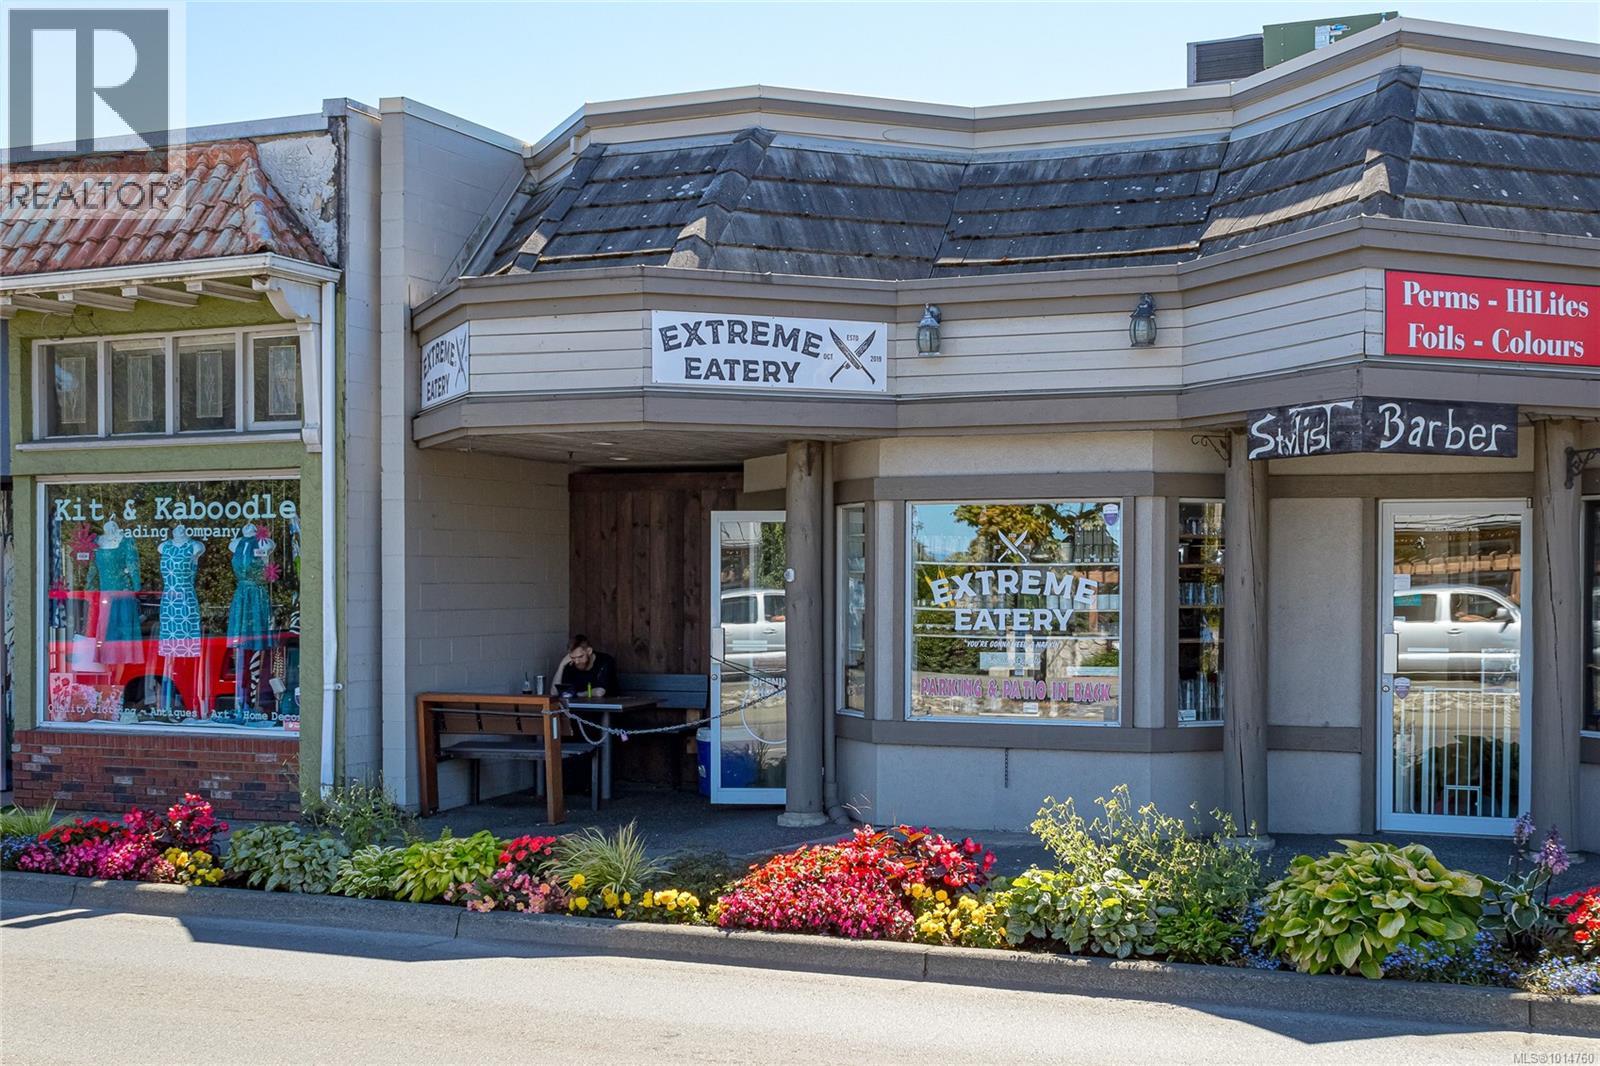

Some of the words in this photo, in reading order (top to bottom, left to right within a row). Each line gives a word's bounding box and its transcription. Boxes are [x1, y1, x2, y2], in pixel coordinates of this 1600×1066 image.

[1402, 281, 1480, 310] Perms
[1506, 288, 1589, 318] HiLites
[658, 319, 823, 358] EXTREME
[1408, 323, 1465, 351] Foils
[1492, 328, 1585, 358] Colours
[424, 340, 456, 379] EXTREME
[684, 356, 800, 383] EATERY
[427, 373, 450, 401] EATERY
[1379, 403, 1507, 452] Barber
[54, 497, 104, 521] Kit
[123, 499, 137, 520] &
[154, 494, 297, 520] Kaboodle
[117, 525, 169, 539] rading
[931, 569, 1099, 605] EXTREME
[954, 608, 1074, 632] EATERY
[920, 678, 982, 698] PARKING
[987, 679, 998, 699] &
[1002, 680, 1047, 700] PATIO
[1052, 682, 1069, 701] IN
[1074, 682, 1111, 702] BACK
[151, 707, 197, 719] Antiques
[211, 709, 230, 719] Art
[243, 711, 268, 720] Home
